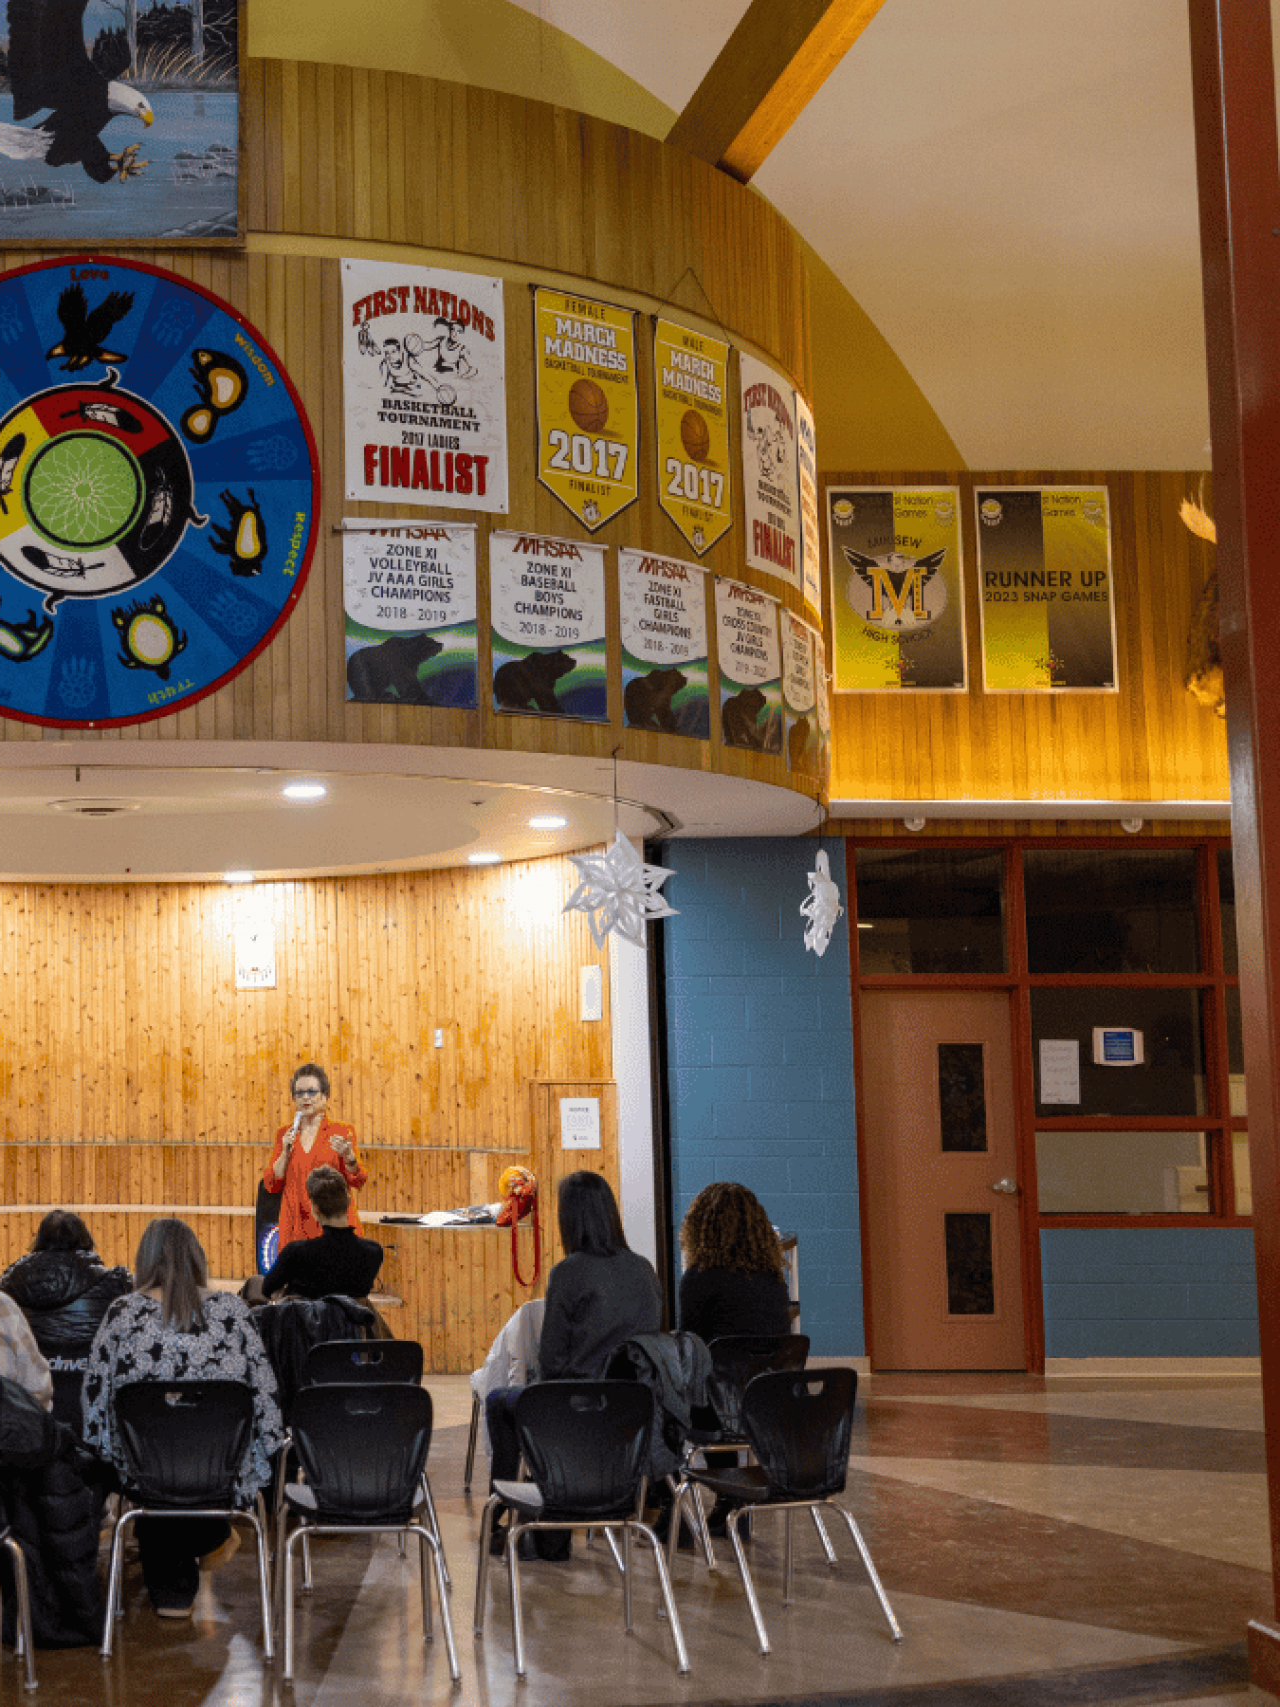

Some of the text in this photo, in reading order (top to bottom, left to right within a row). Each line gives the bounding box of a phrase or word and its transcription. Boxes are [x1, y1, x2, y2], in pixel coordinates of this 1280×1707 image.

[70, 267, 109, 281] Love
[352, 286, 495, 342] FIRST NATIONS
[565, 298, 606, 320] FEMALE
[555, 316, 617, 348] MARCH
[682, 335, 704, 351] MALE
[544, 335, 628, 372] MADNESS
[670, 350, 715, 381] MARCH
[663, 367, 721, 404] MADNESS
[381, 398, 477, 419] BASKETBALL
[377, 411, 480, 432] TOURNAMENT
[401, 430, 460, 450] 2017 LADIES
[549, 429, 628, 481] 2017
[363, 443, 489, 496] FINALIST
[569, 480, 612, 496] FINALIST
[666, 457, 725, 508] 2017
[282, 512, 306, 577] Respect
[386, 544, 437, 560] ZONE XI
[512, 536, 583, 562] MHSAA
[753, 518, 795, 575] FINALIST
[370, 557, 452, 576] VOLLEYBALL
[526, 561, 571, 579] ZONE XI
[638, 557, 690, 582] MHSAA
[368, 572, 454, 589] JV AAA GIRLS
[521, 574, 577, 593] BASEBALL
[985, 570, 1106, 587] RUNNER UP
[371, 586, 451, 604] CHAMPIONS
[534, 589, 564, 605] BOYS
[648, 581, 682, 598] ZONE XI
[985, 591, 1108, 602] 2023 SNAP GAMES
[514, 602, 583, 621] CHAMPIONS
[644, 593, 687, 612] FASTBALL
[376, 605, 407, 619] 2018
[418, 609, 446, 622] 2019
[654, 609, 679, 623] GIRLS
[722, 615, 746, 630] CROSS
[519, 621, 546, 636] 2018
[555, 625, 580, 640] 2019
[638, 618, 691, 640] CHAMPIONS
[730, 643, 769, 661] CHAMPIONS
